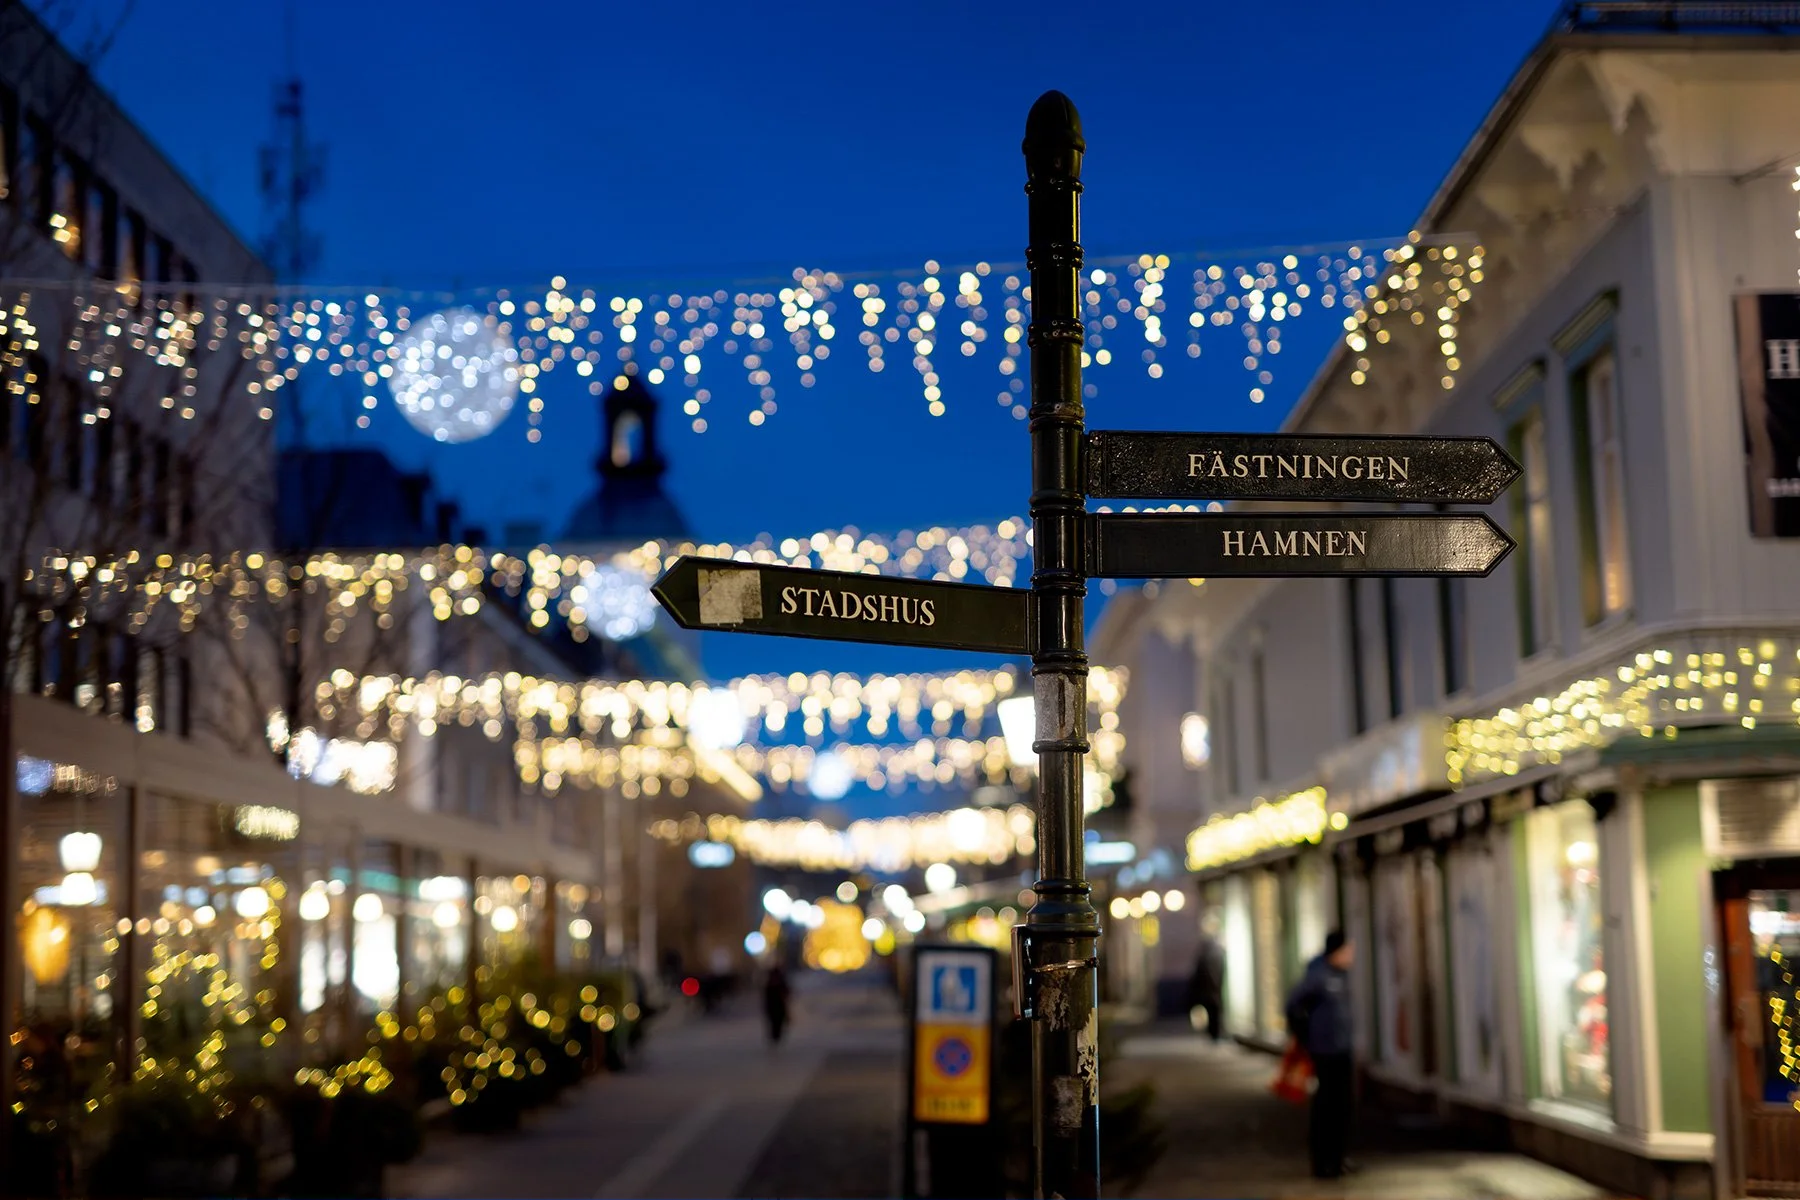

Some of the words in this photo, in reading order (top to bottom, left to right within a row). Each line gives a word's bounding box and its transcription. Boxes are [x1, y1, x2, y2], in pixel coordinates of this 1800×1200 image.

[1187, 451, 1411, 481] FÄSTNINGEN
[1222, 530, 1368, 557] HAMNEN
[780, 586, 936, 627] STADSHUS
